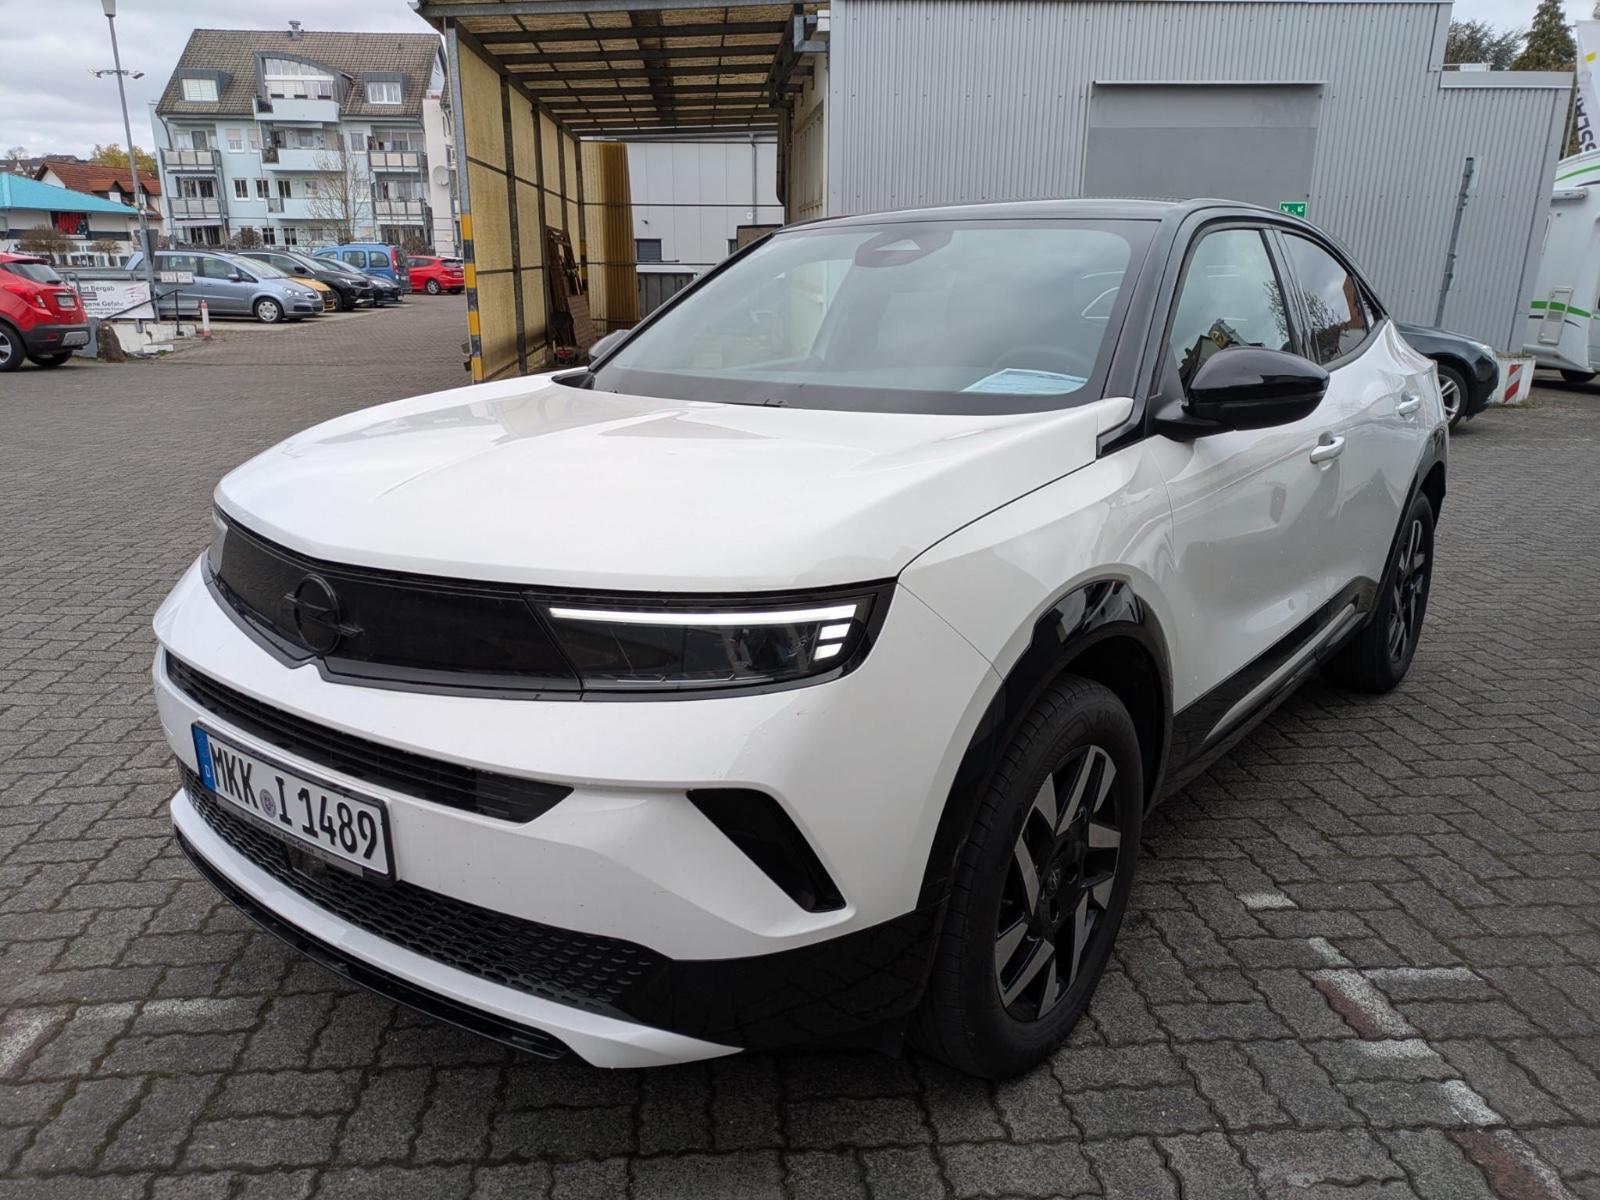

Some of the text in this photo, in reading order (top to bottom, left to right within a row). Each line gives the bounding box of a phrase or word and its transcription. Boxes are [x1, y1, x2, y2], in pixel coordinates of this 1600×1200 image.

[90, 285, 115, 293] Bergab
[209, 742, 259, 810] MKK
[297, 787, 378, 860] 1489
